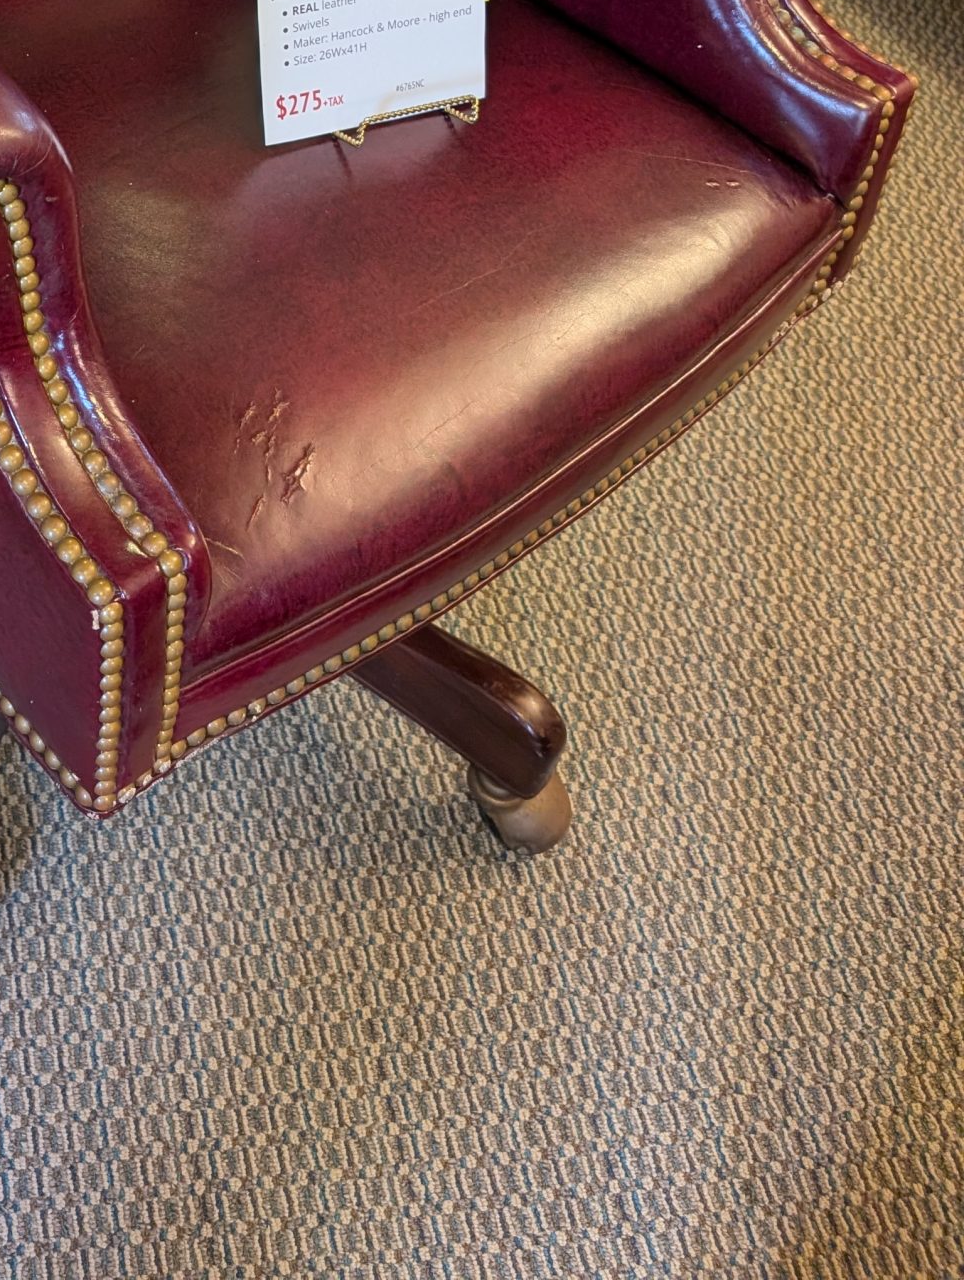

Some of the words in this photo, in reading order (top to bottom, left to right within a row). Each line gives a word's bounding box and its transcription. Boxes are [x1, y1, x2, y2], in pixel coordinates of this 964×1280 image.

[292, 2, 320, 16] REAL
[292, 17, 330, 33] Swivels
[293, 34, 328, 49] Maker:
[331, 23, 374, 41] Hancock
[377, 21, 385, 32] &
[388, 17, 420, 31] Moore
[429, 9, 450, 26] high
[453, 5, 472, 19] end
[293, 53, 317, 67] Size:
[319, 42, 367, 61] 26Wx41H
